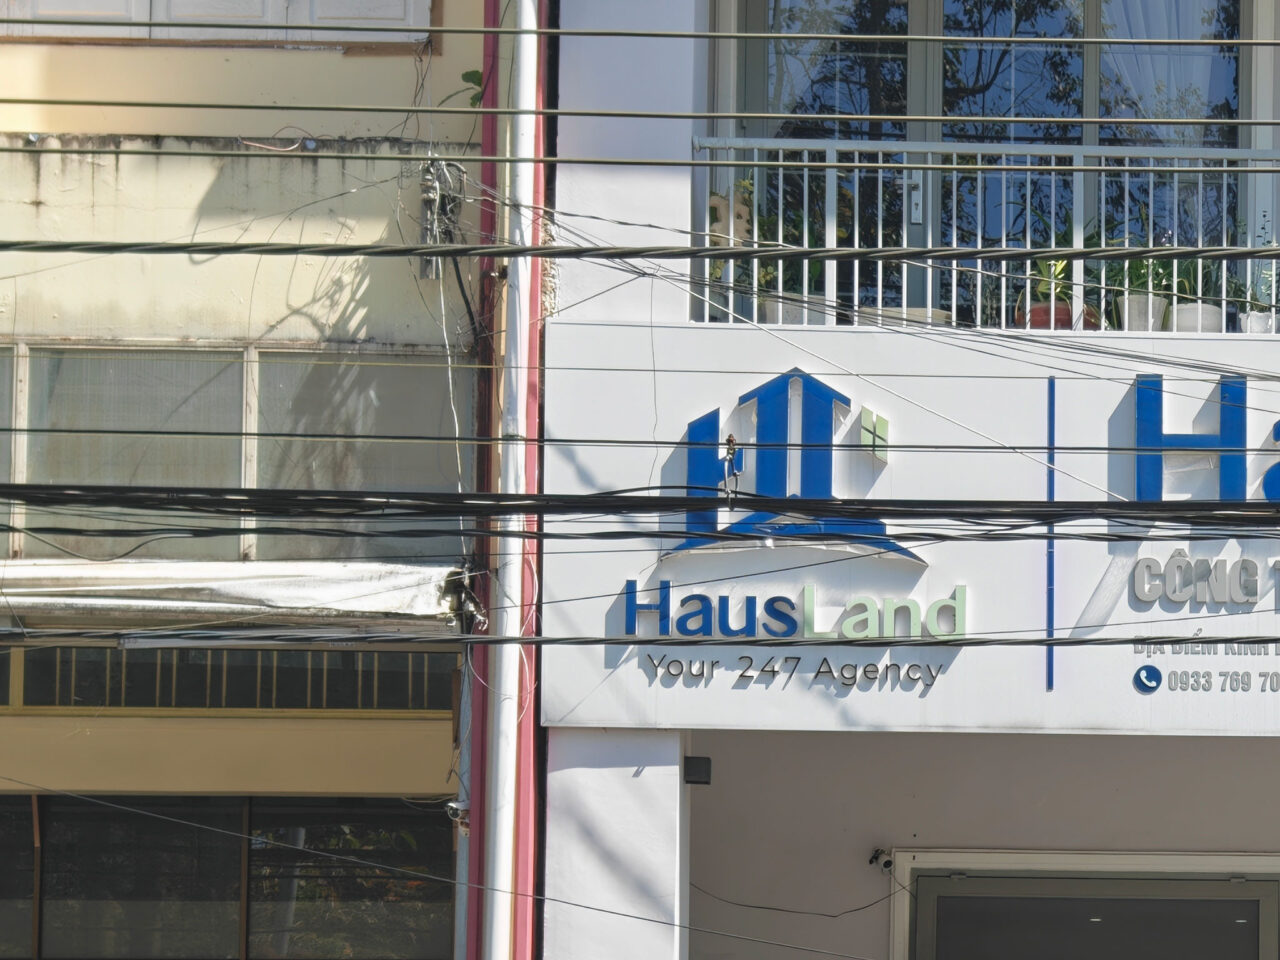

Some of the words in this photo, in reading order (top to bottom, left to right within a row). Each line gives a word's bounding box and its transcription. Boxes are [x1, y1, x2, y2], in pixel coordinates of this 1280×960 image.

[1134, 548, 1258, 604] CÔNG
[624, 580, 966, 639] HausLand
[648, 655, 719, 681] Your
[739, 657, 801, 683] 247
[814, 656, 943, 690] Agency
[1168, 670, 1213, 692] 0933
[1219, 671, 1252, 692] 769
